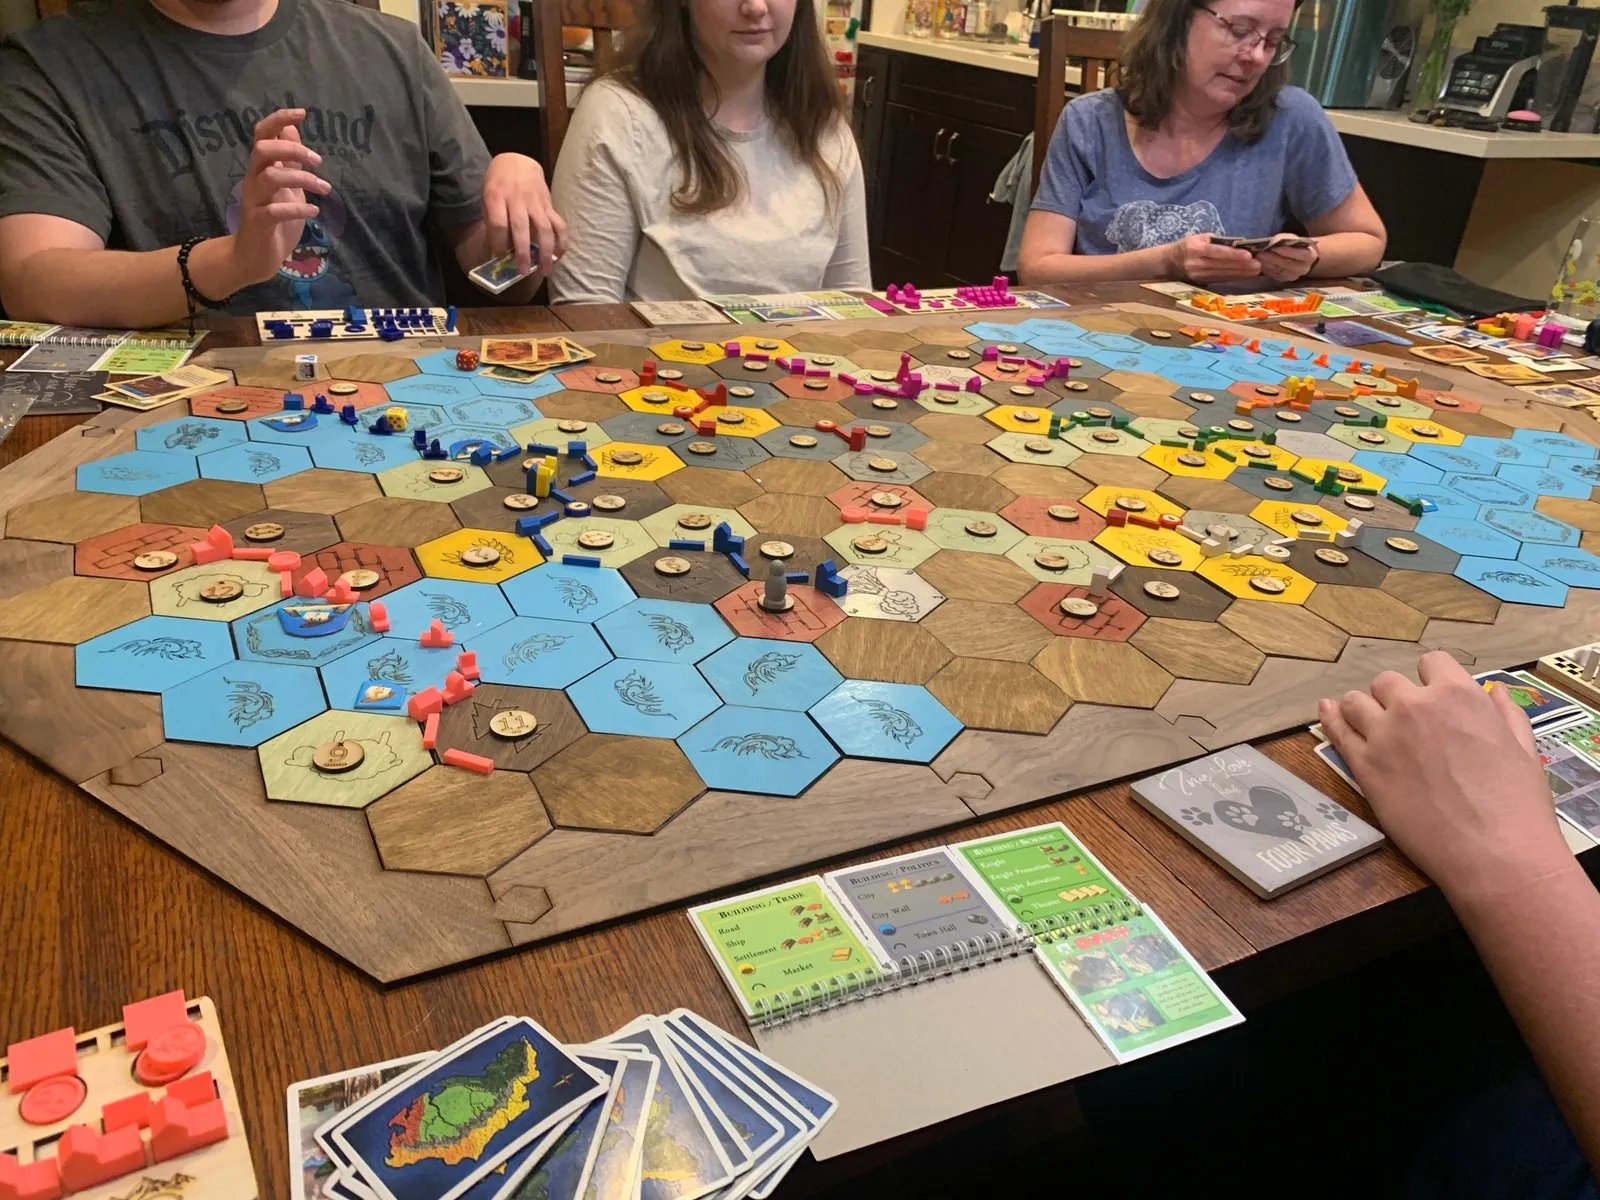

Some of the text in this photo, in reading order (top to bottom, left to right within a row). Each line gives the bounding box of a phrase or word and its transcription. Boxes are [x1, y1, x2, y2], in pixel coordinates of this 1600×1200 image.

[206, 586, 234, 597] 12
[498, 715, 529, 731] 11
[329, 747, 348, 762] 9
[1212, 756, 1252, 780] Love
[1256, 822, 1358, 872] FOUR PAWS
[849, 871, 894, 886] BUILDING
[899, 859, 941, 874] POLITICS
[857, 891, 876, 901] City
[718, 901, 766, 919] BUILDING
[772, 891, 805, 905] TRADE
[871, 904, 911, 920] City Wall
[718, 924, 740, 936] Road
[914, 923, 957, 941] Town Hall
[725, 938, 746, 949] Ship
[733, 946, 778, 963] Settlement
[782, 962, 814, 977] Market
